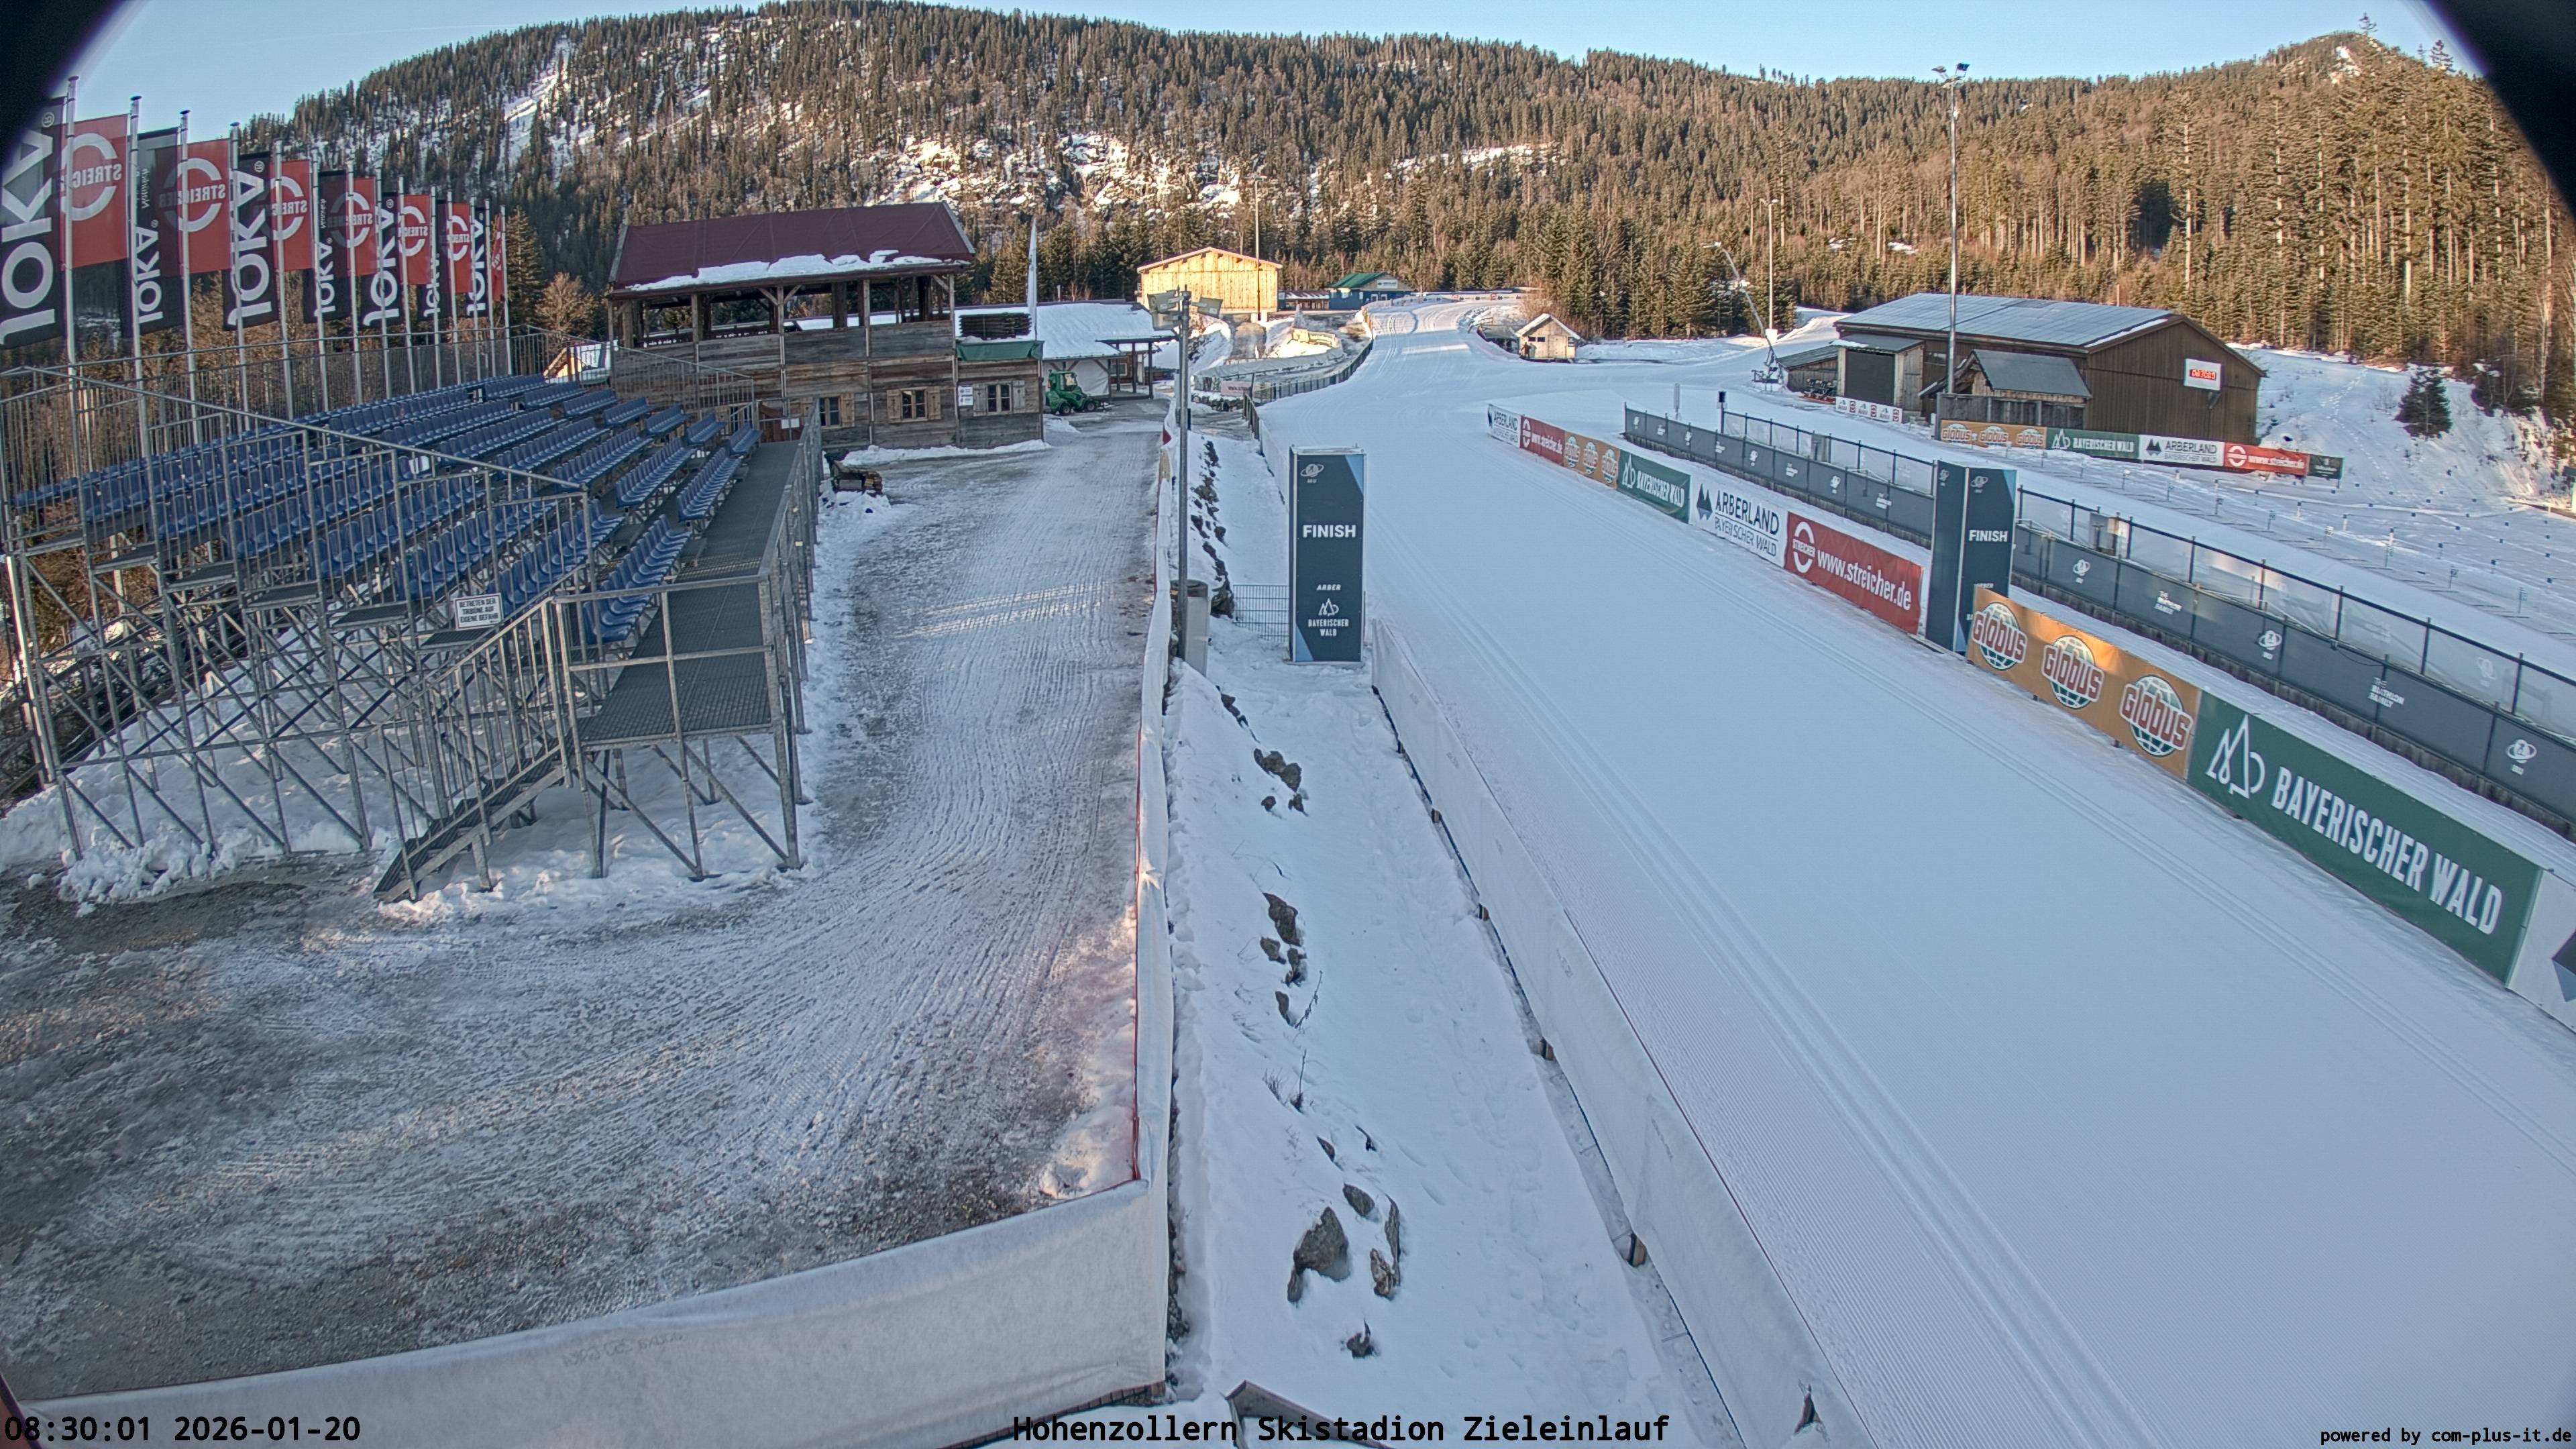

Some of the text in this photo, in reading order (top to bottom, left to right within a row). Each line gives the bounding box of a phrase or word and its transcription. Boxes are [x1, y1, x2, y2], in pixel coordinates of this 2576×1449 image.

[2073, 437, 2134, 453] BAYERISCHER WALD
[2165, 441, 2217, 454] ARBERLAND
[1715, 490, 1779, 535] ARBERLAND
[1303, 525, 1356, 538] FINISH
[1968, 529, 2008, 543] FINISH
[1756, 536, 1776, 557] WALD
[1817, 549, 1911, 610] www.streicher.de
[1308, 619, 1349, 627] BAYERISCHER
[1320, 629, 1337, 637] WALD
[2271, 766, 2502, 934] BAYERISCHER WALD
